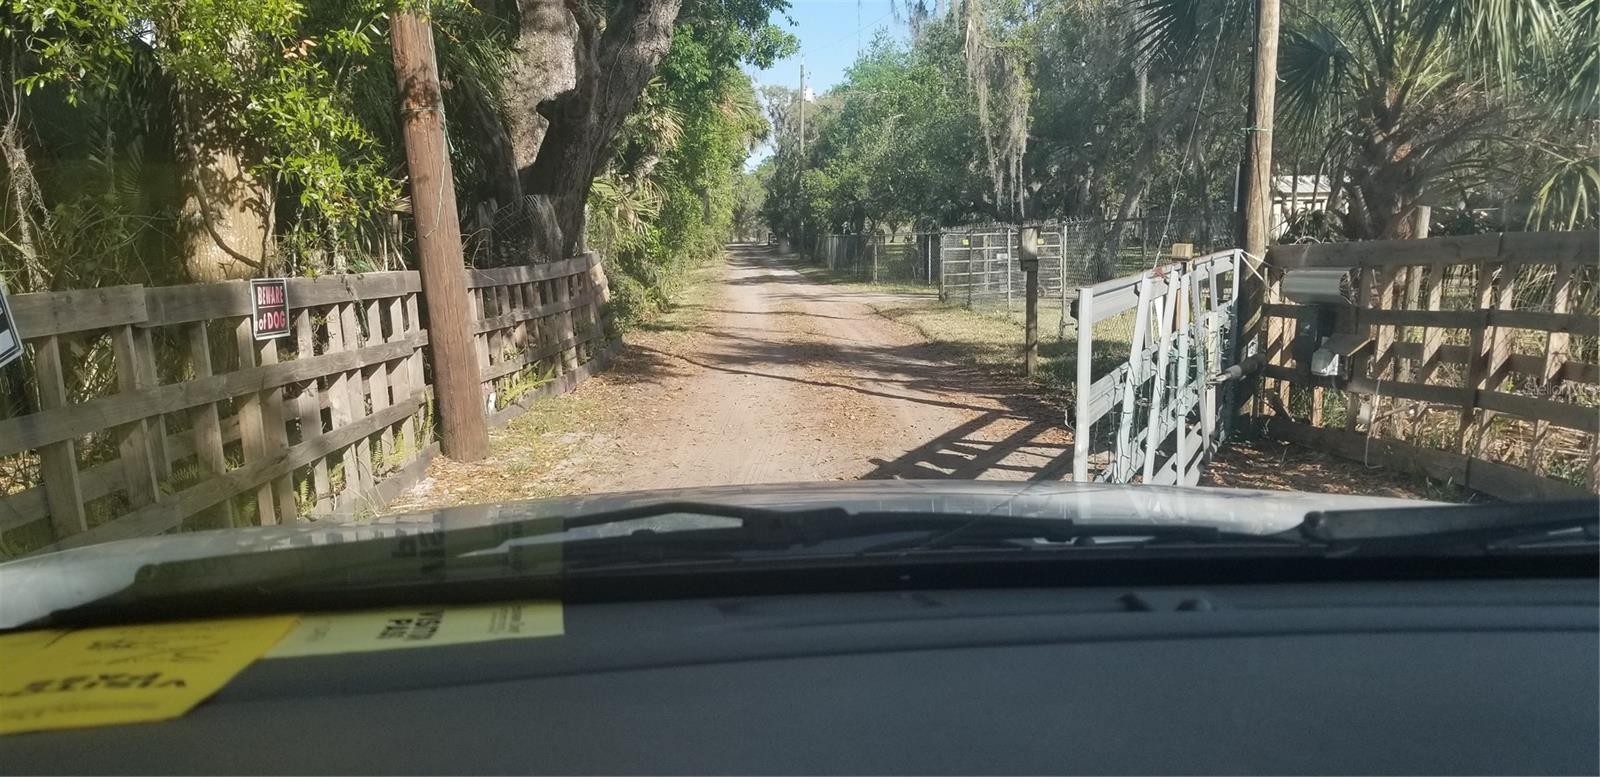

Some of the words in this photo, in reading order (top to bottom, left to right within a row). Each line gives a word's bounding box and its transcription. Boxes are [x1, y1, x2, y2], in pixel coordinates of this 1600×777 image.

[257, 286, 283, 305] BEWARE
[258, 313, 266, 330] of
[267, 311, 285, 329] DOG
